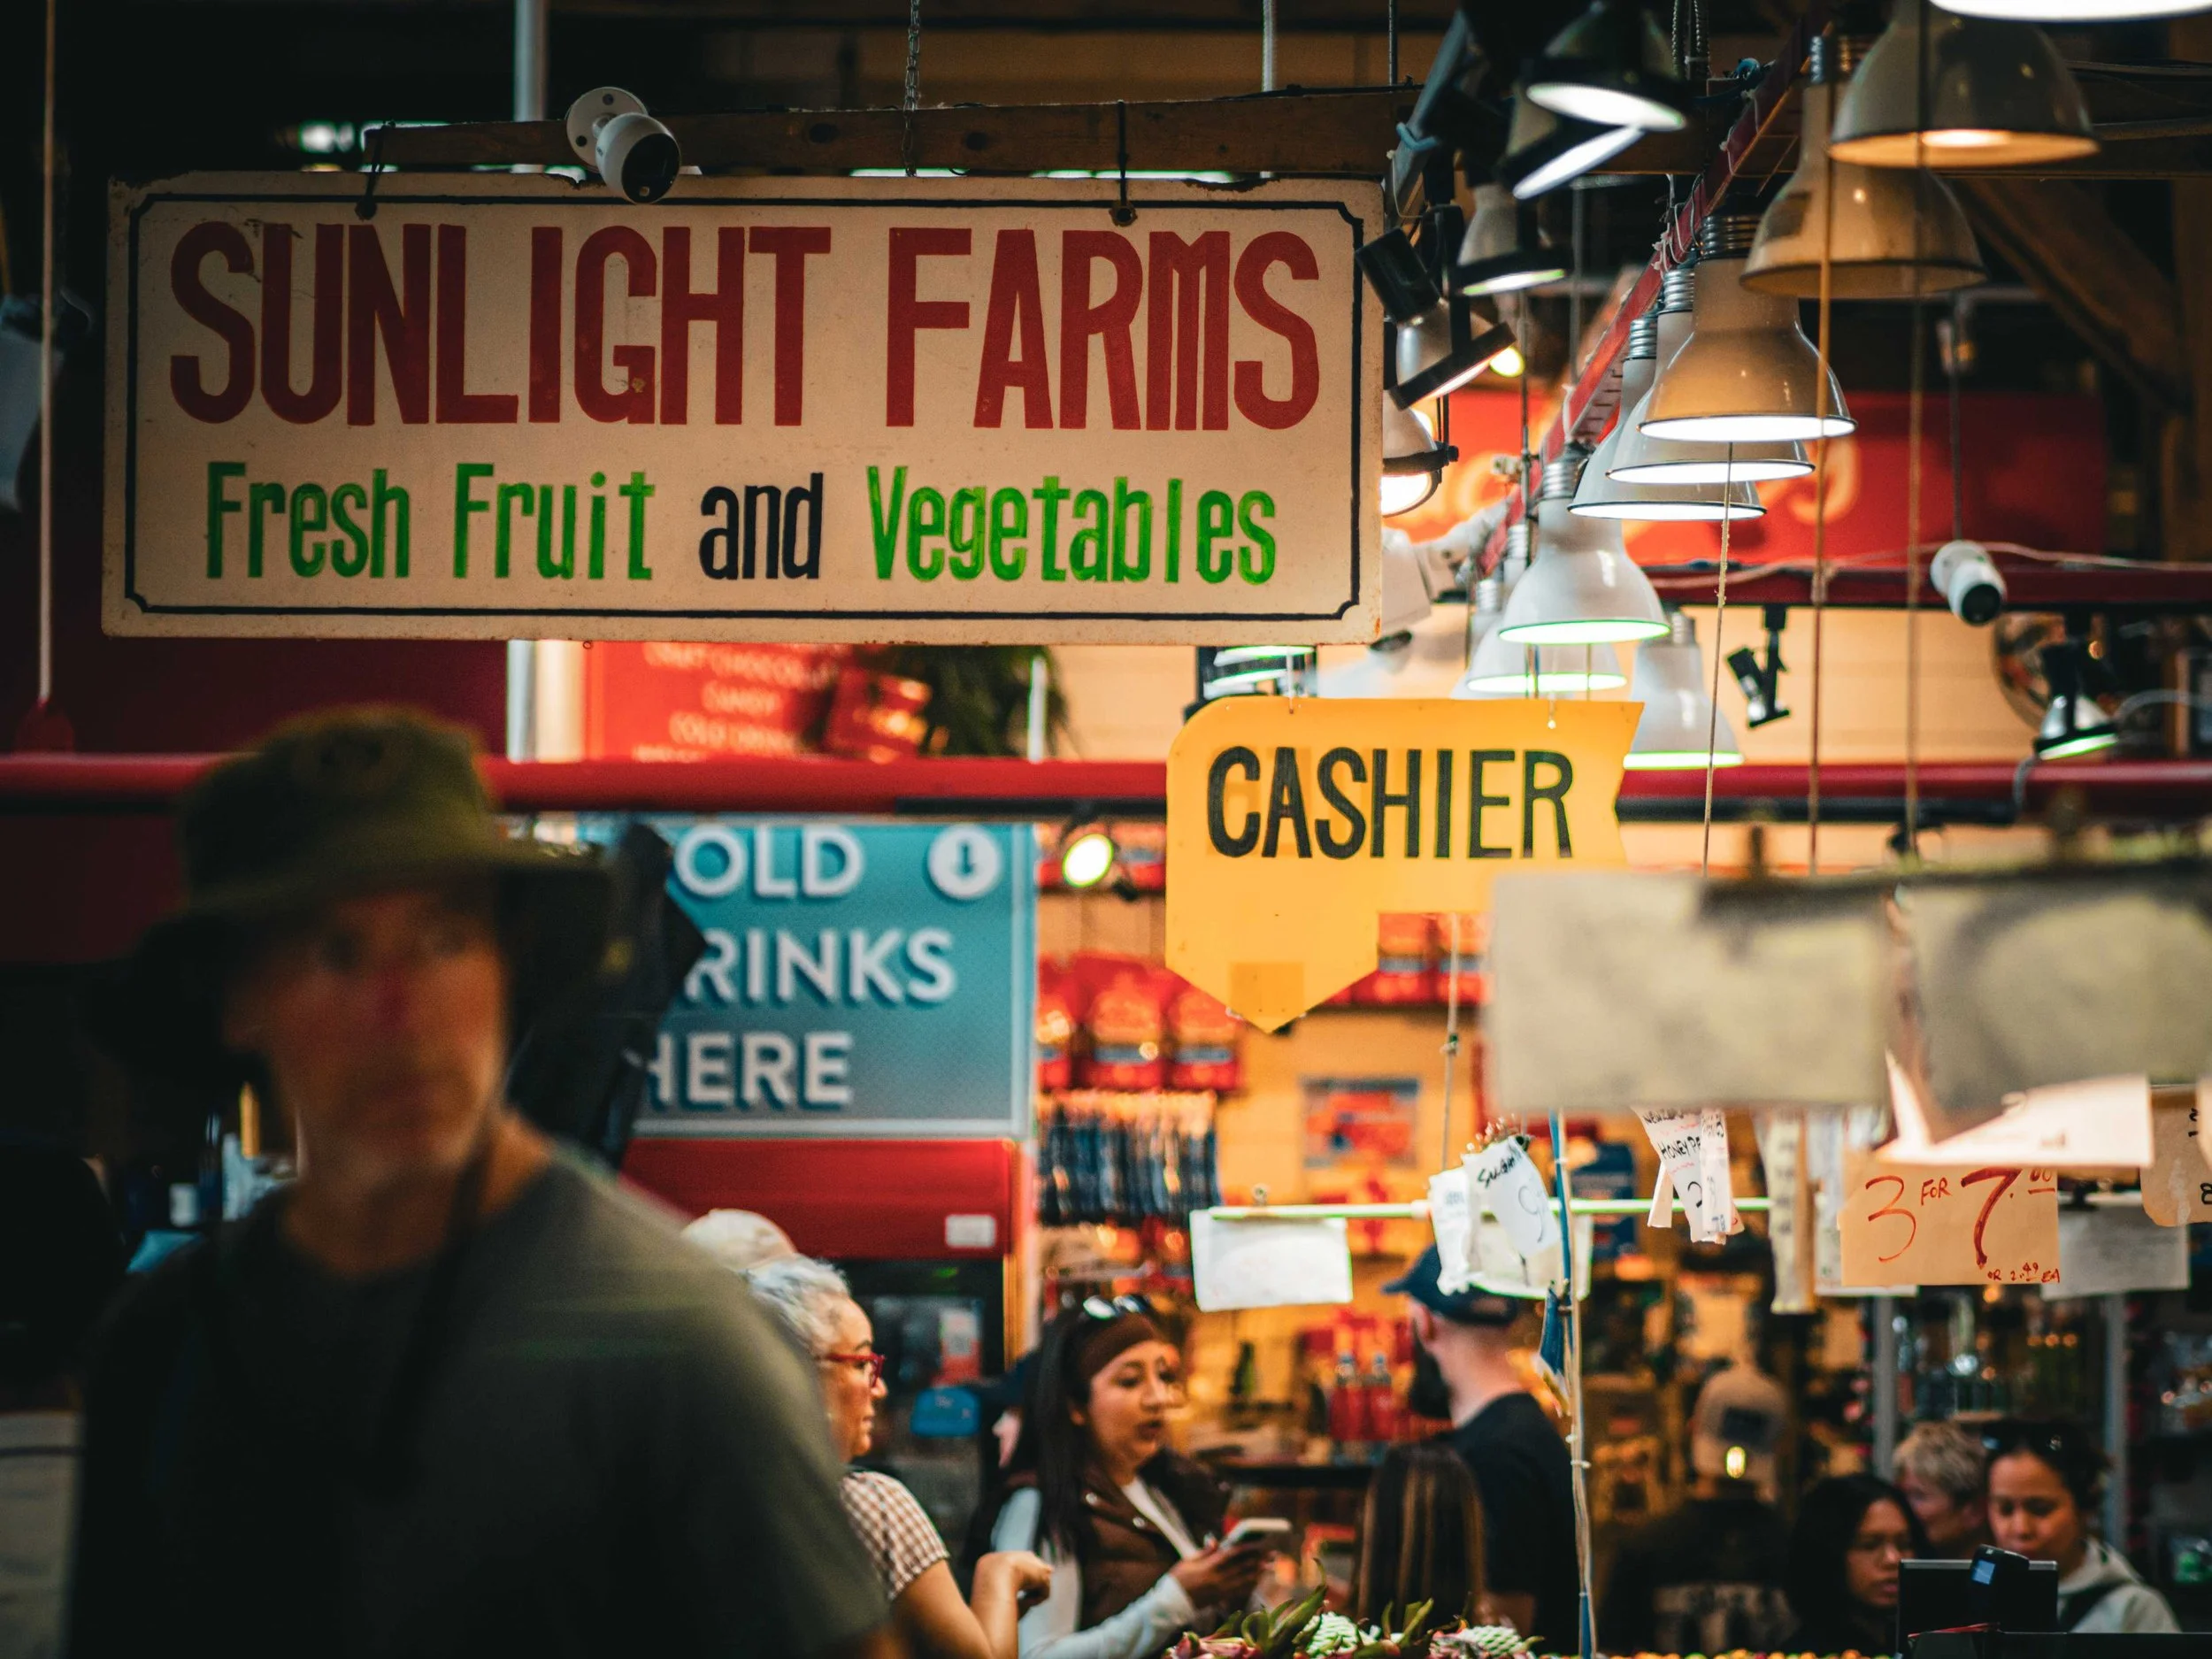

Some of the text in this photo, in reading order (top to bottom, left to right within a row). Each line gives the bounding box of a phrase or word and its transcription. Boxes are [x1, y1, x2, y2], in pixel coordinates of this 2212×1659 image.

[170, 221, 1319, 430] SUNLIGHT FARMS
[206, 461, 1276, 585] Fresh Fruit and Vegetables
[1207, 746, 1573, 859] CASHIER
[674, 824, 864, 897] OLD
[684, 927, 956, 1002] RINKS
[1865, 1175, 1916, 1263] 3
[1920, 1178, 1951, 1205] FOR
